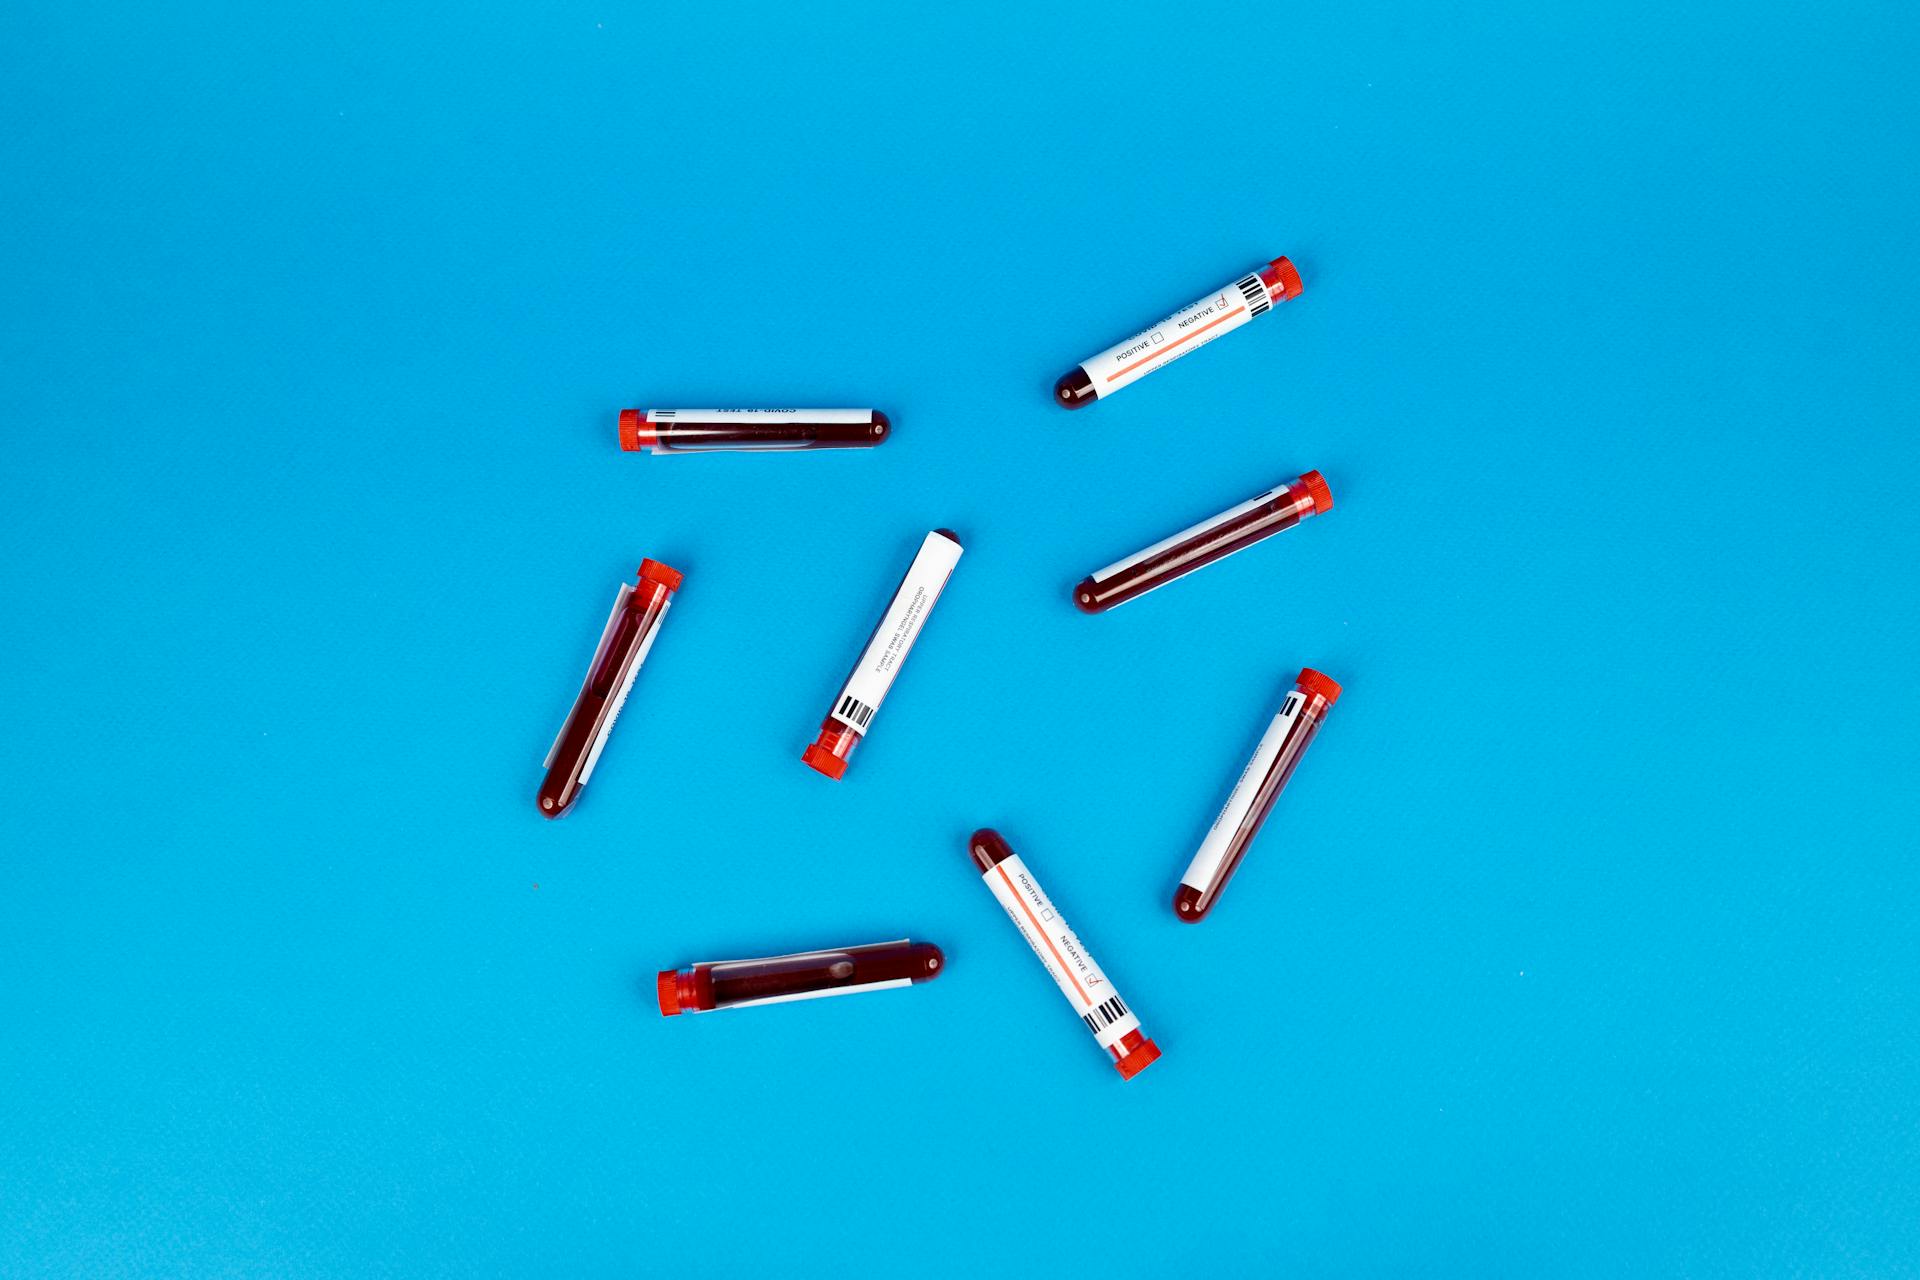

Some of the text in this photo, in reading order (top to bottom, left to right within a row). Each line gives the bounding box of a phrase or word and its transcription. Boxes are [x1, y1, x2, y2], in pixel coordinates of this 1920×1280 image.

[1116, 306, 1213, 361] POSITIVE NEGATIVE
[883, 593, 928, 671] UPPER RESPIRATORY TRACT
[887, 632, 900, 649] SWAB
[875, 649, 890, 673] SAMPLE
[1018, 873, 1043, 907] POSITIVE
[1059, 935, 1087, 972] NEGATIVE
